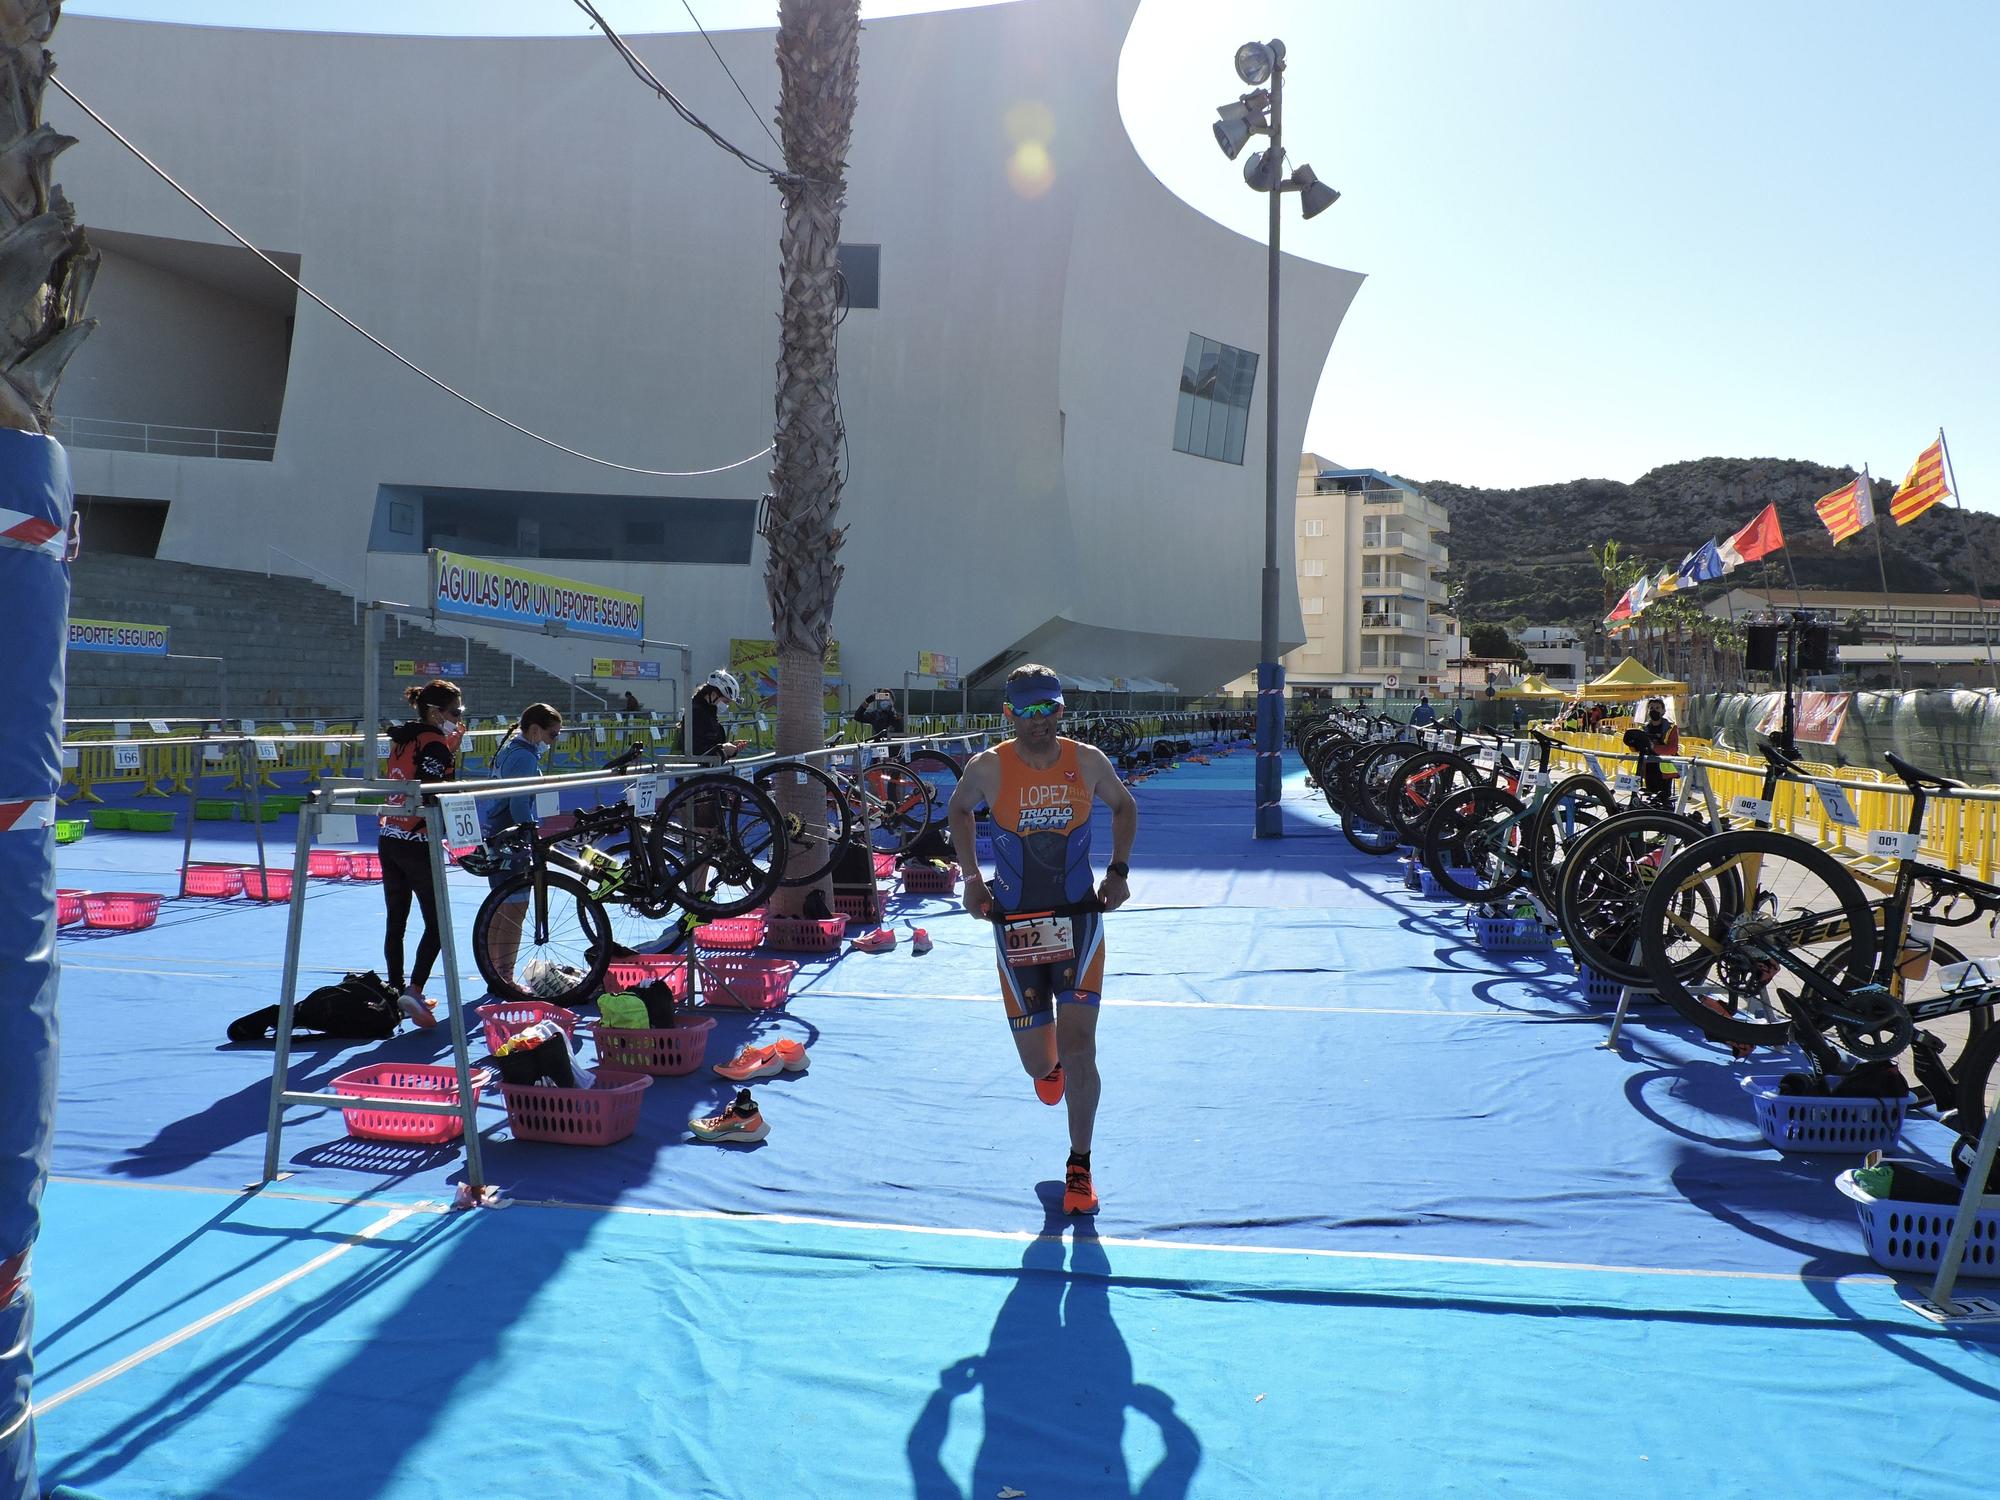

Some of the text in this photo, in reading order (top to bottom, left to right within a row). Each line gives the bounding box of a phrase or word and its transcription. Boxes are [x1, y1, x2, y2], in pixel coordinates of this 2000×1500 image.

[438, 556, 639, 630] ÁGUILAS POR UN DEPORTE SEGURO
[68, 625, 164, 647] EPORTE SEGURO
[117, 752, 138, 764] 166
[259, 745, 276, 757] 167
[640, 790, 652, 808] 57
[1020, 784, 1070, 806] LOPEZ
[1741, 800, 1757, 810] 002
[1830, 798, 1843, 816] 2
[454, 813, 474, 836] 56
[1017, 816, 1073, 832] PRAT
[1878, 836, 1898, 847] 001
[1009, 931, 1042, 949] 012
